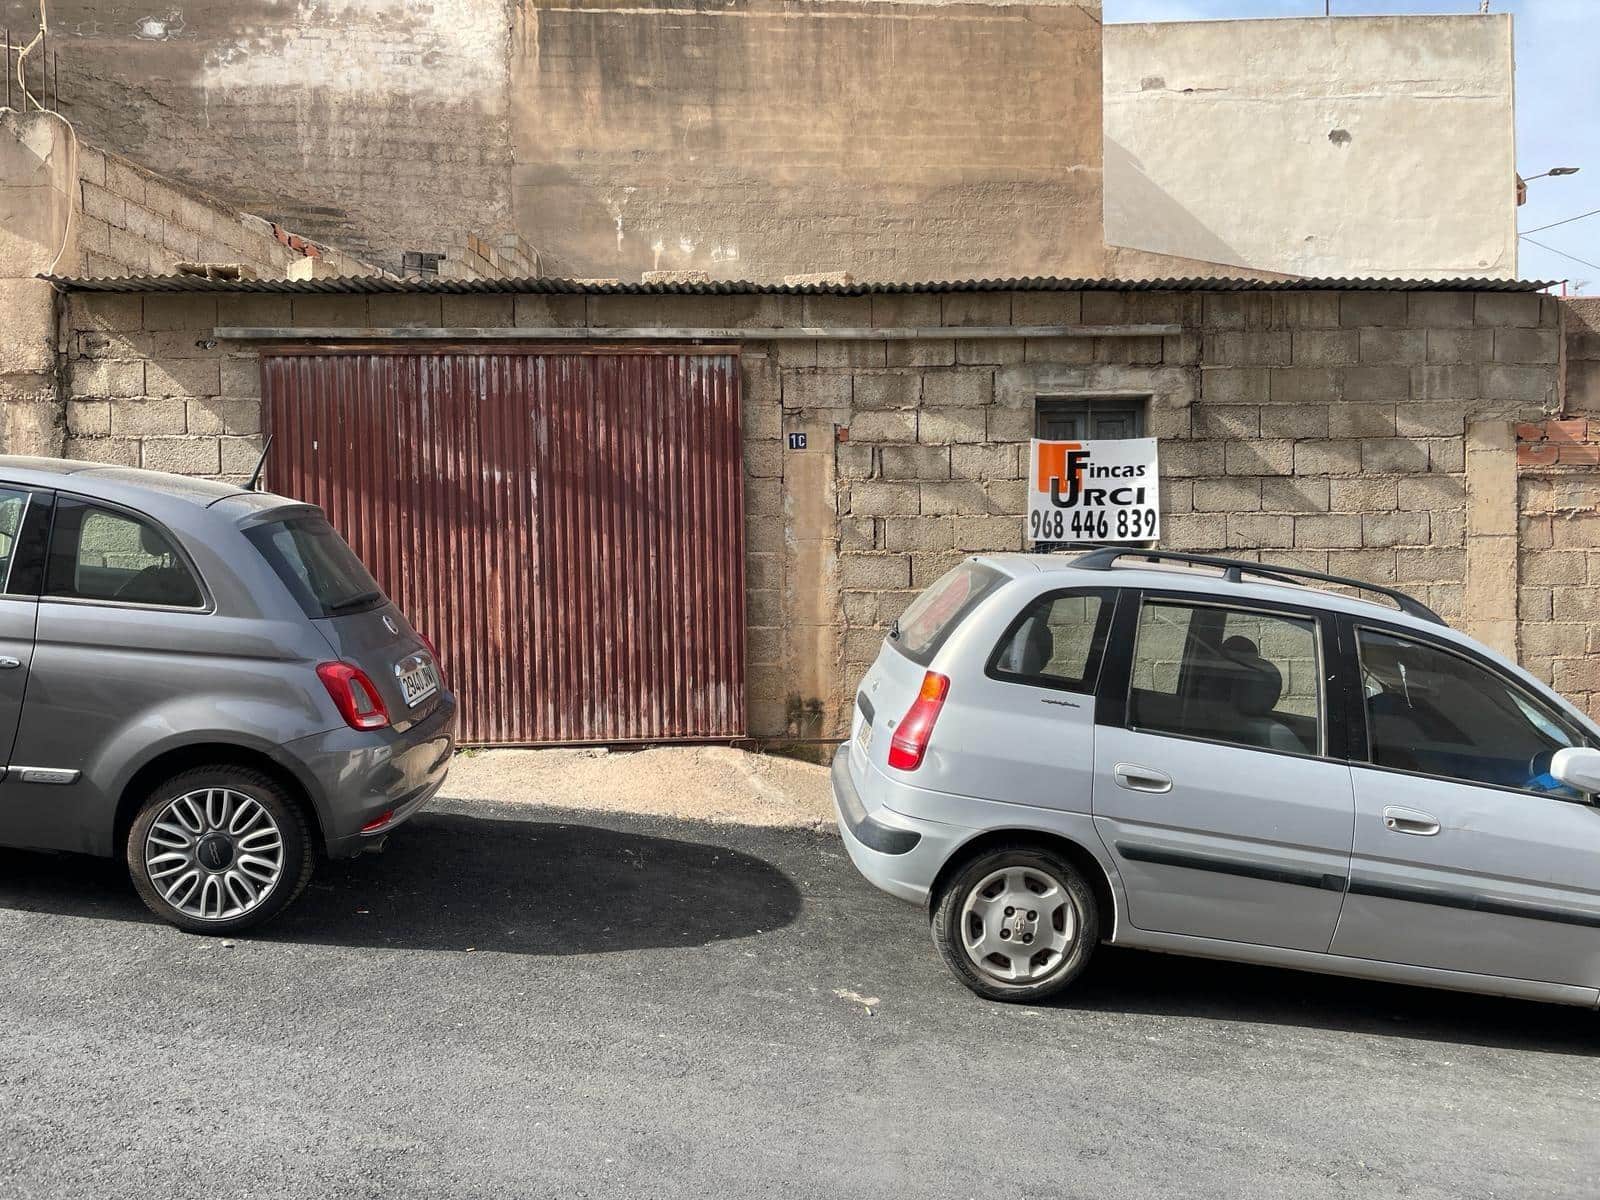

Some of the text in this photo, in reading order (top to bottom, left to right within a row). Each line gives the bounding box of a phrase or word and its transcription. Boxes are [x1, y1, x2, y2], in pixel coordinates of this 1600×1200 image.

[1067, 451, 1146, 481] Fincas
[1050, 477, 1146, 508] URCI
[1031, 508, 1156, 539] 968 446 839
[402, 671, 425, 697] 2940
